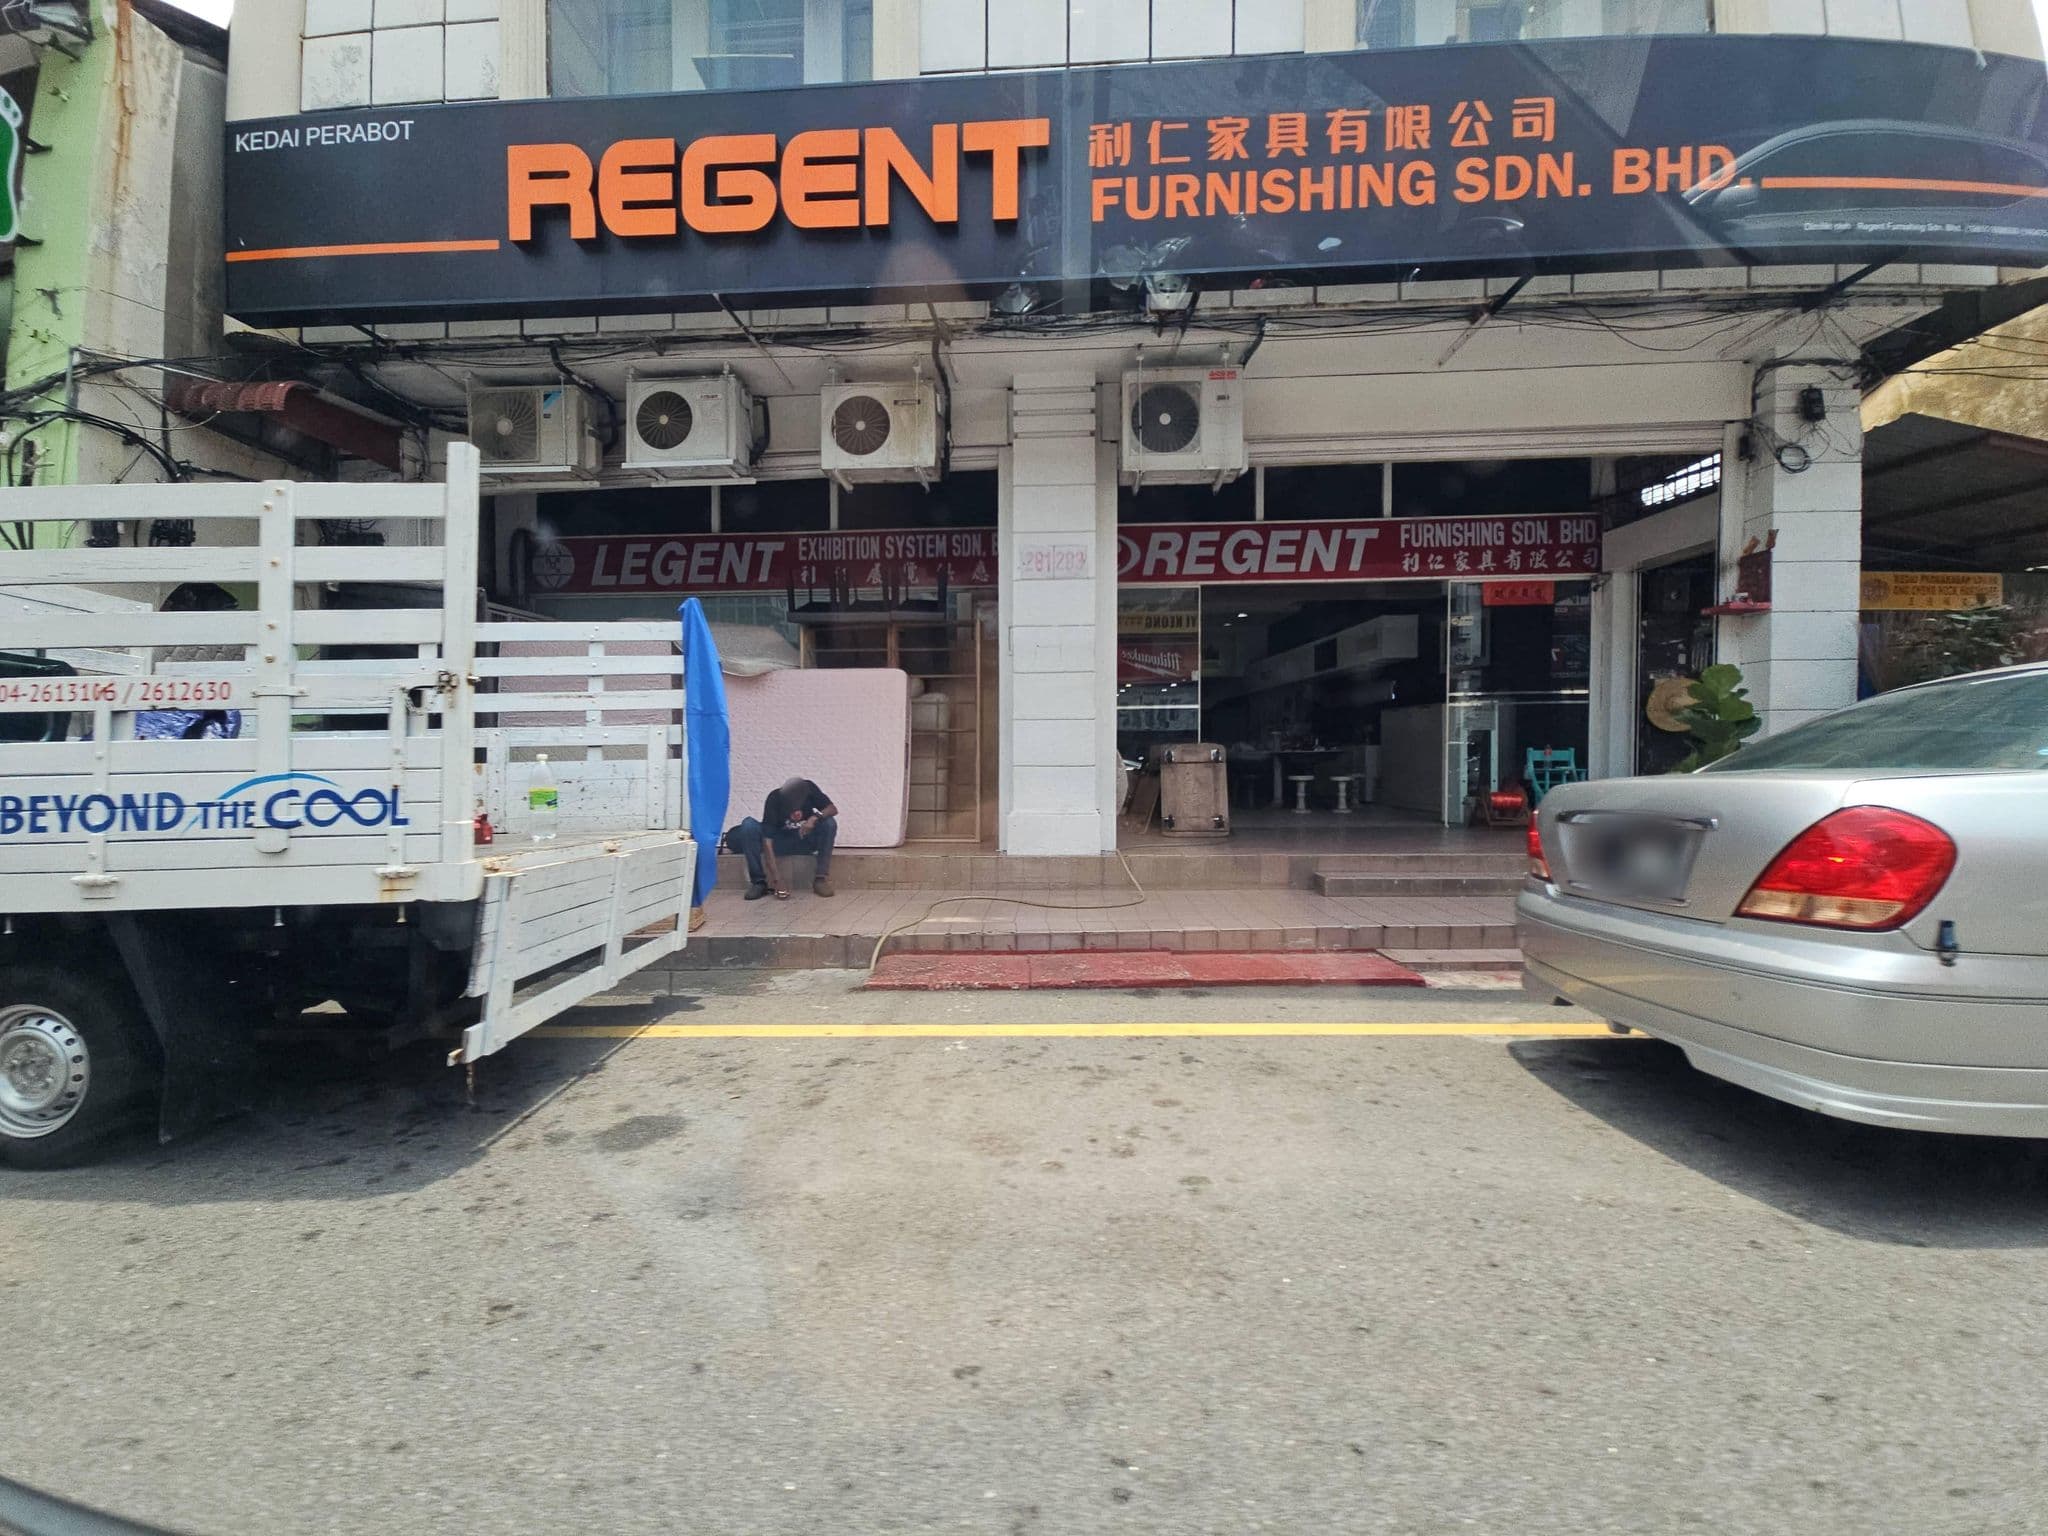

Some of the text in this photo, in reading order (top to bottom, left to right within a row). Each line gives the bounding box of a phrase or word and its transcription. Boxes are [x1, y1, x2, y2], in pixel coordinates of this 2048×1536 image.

[235, 120, 415, 152] KEDAI PERABOT
[1088, 96, 1556, 168] 利仁家具有限公司
[507, 117, 1050, 242] REGENT
[1091, 144, 1754, 222] FURNISHING SDN. BHD.
[798, 535, 880, 561] EXHIBITION
[885, 533, 947, 559] SYSTEM
[952, 532, 987, 557] SDN.
[1143, 527, 1380, 576] REGENT
[1400, 521, 1505, 548] FURNISHING
[1511, 519, 1553, 545] SDN.
[591, 541, 785, 587] LEGENT
[1402, 548, 1598, 572] 利仁家具有限公司
[141, 681, 232, 702] 2612630
[0, 786, 411, 835] BEYOND THE COOL
